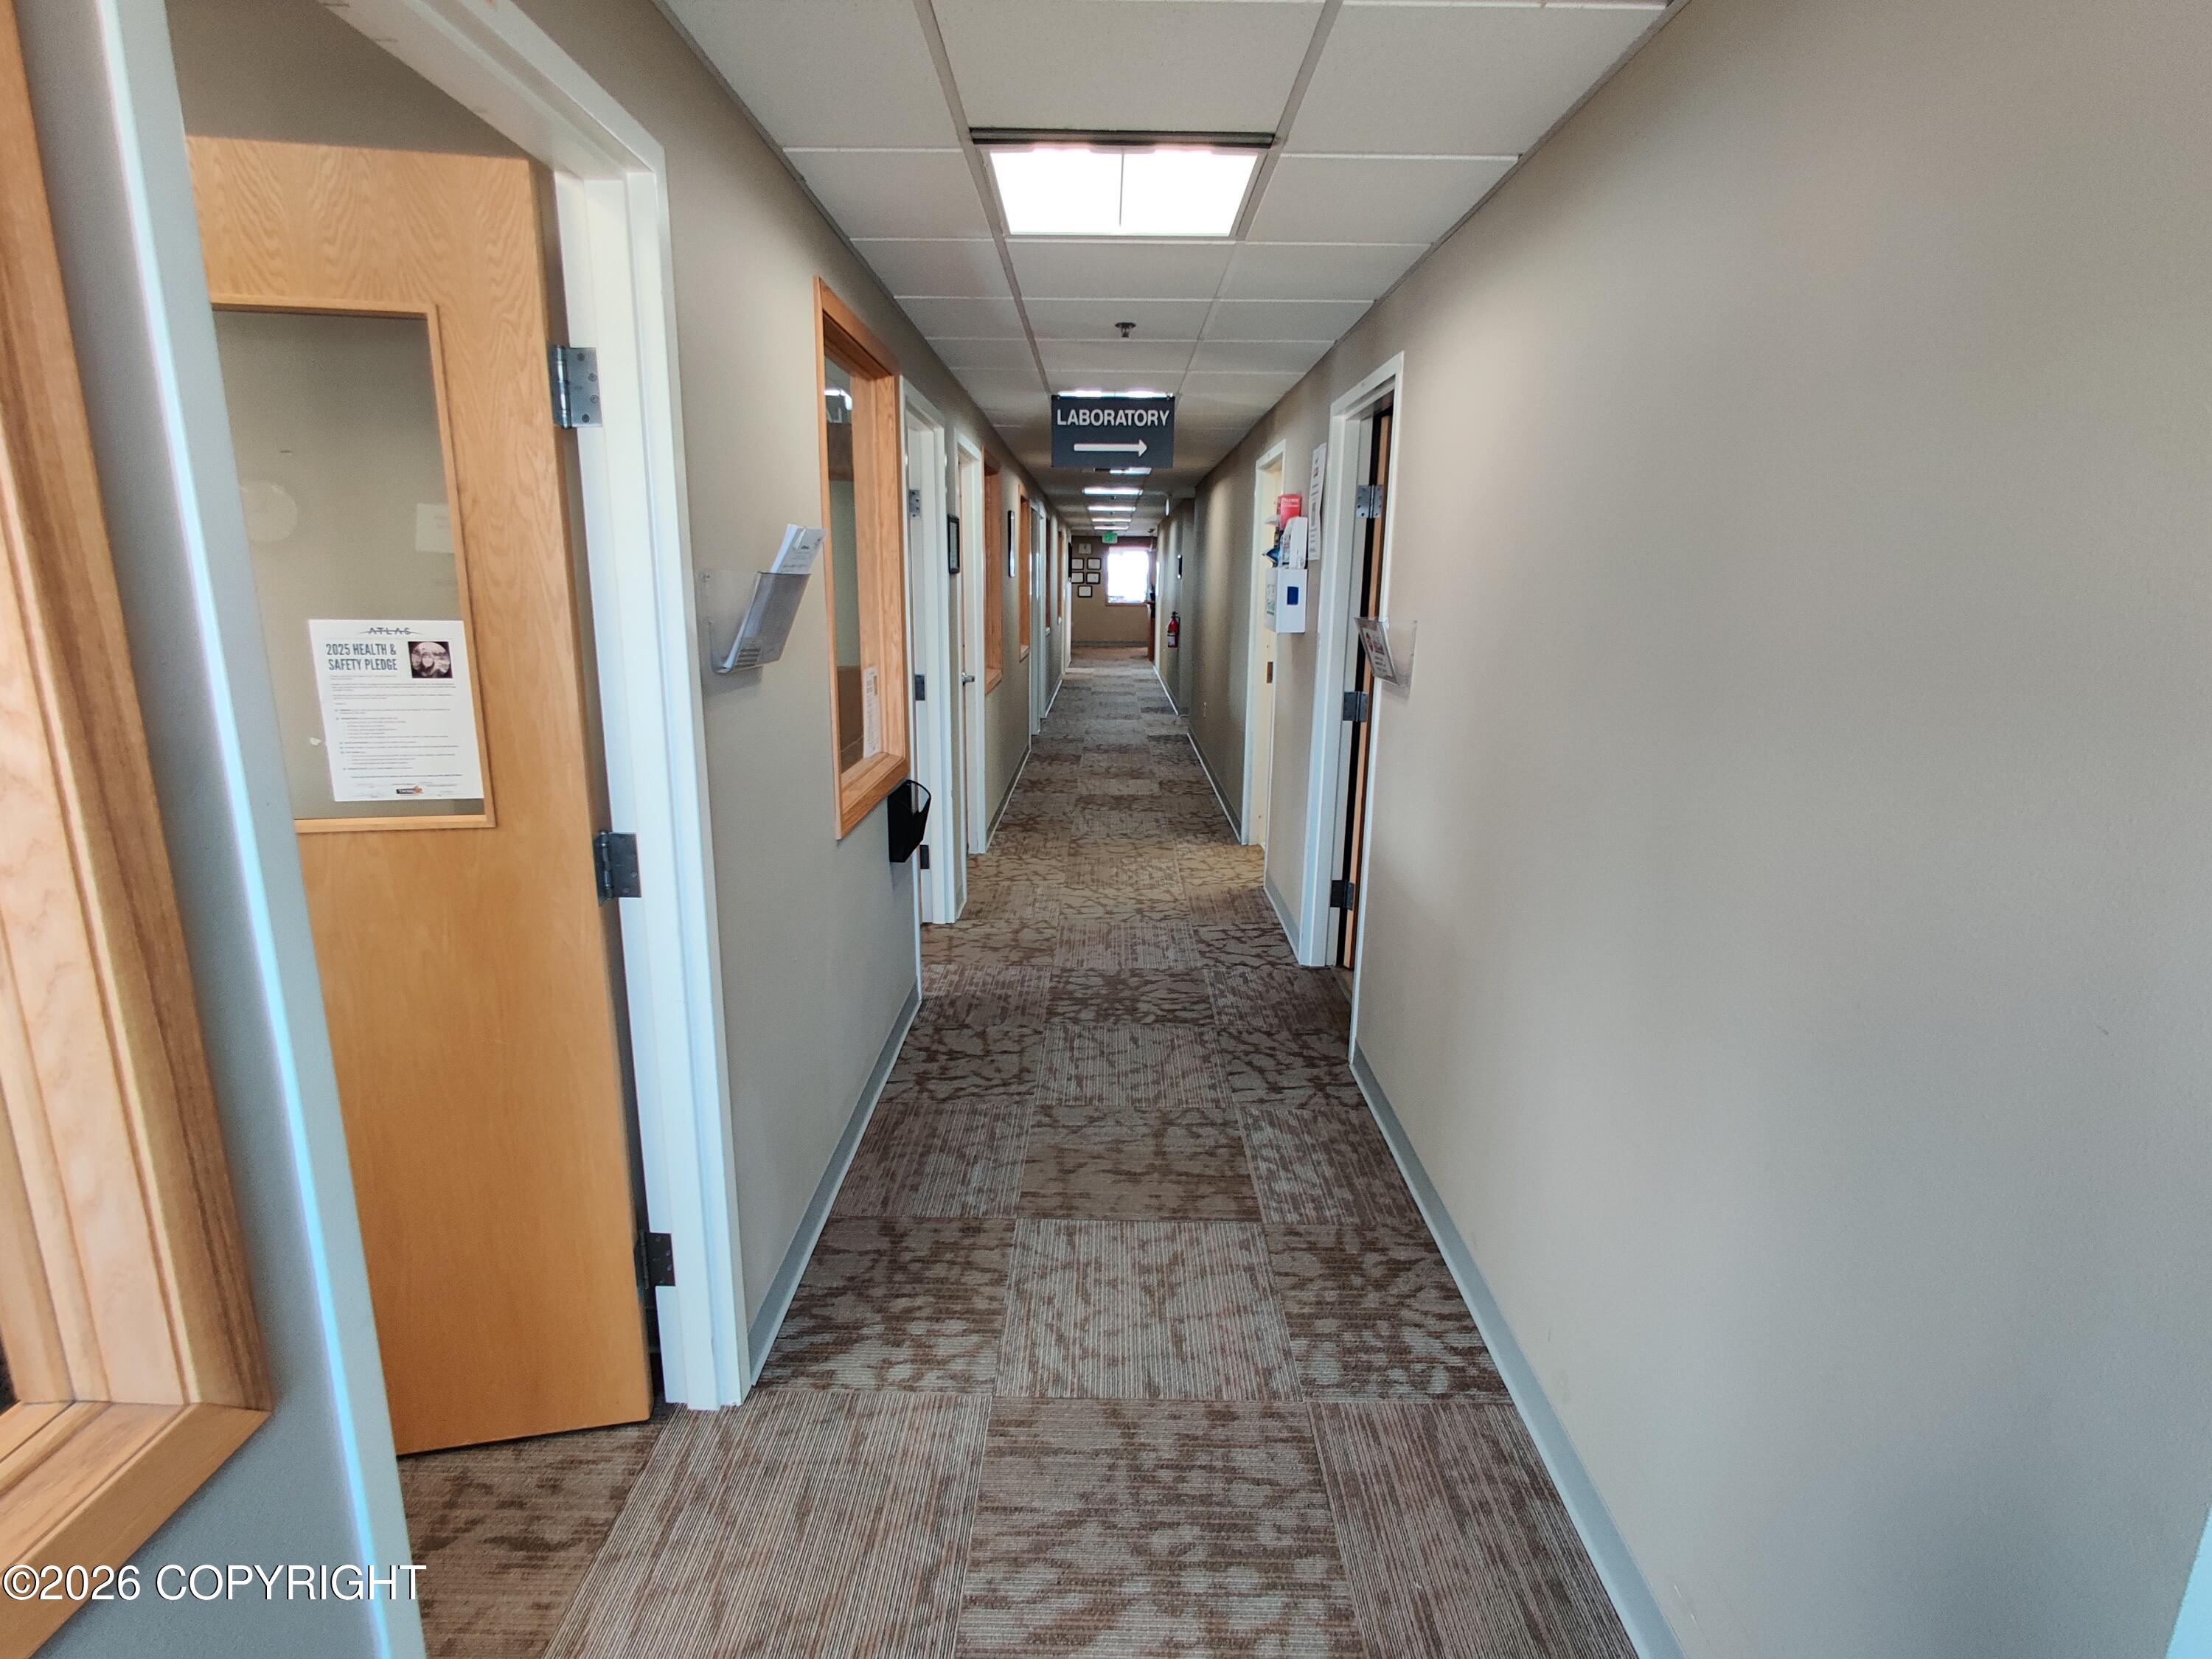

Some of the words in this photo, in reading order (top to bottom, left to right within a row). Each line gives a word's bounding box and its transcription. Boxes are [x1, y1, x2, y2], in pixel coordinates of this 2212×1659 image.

[1057, 408, 1170, 427] LABORATORY
[368, 627, 411, 635] ATLAS
[325, 643, 351, 655] 2025
[352, 643, 388, 655] HEALTH
[389, 643, 397, 655] &
[328, 658, 361, 671] SAFETY
[364, 658, 398, 671] PLEDGE
